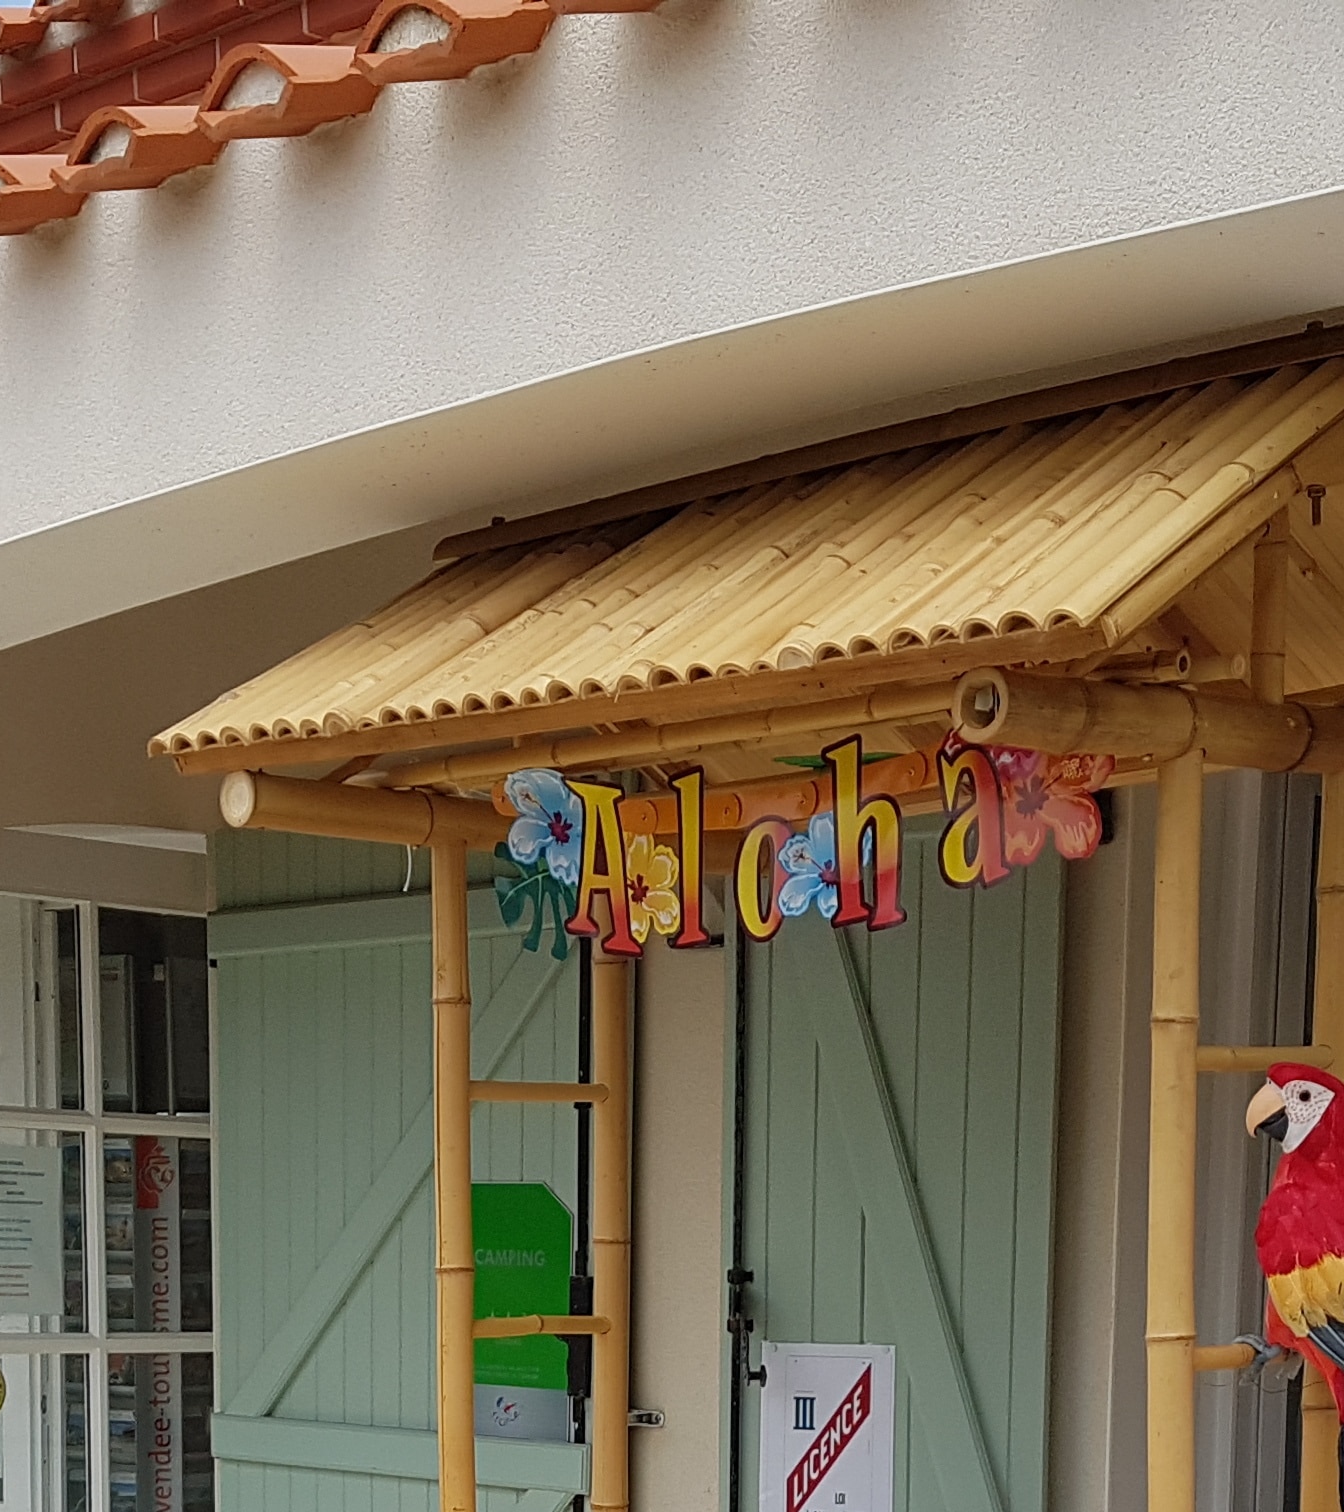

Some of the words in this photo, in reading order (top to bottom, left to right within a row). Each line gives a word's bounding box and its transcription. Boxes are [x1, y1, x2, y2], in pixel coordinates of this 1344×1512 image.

[564, 733, 1012, 957] Aloha
[475, 1247, 546, 1267] CAMPING
[793, 1384, 863, 1509] LICENCE
